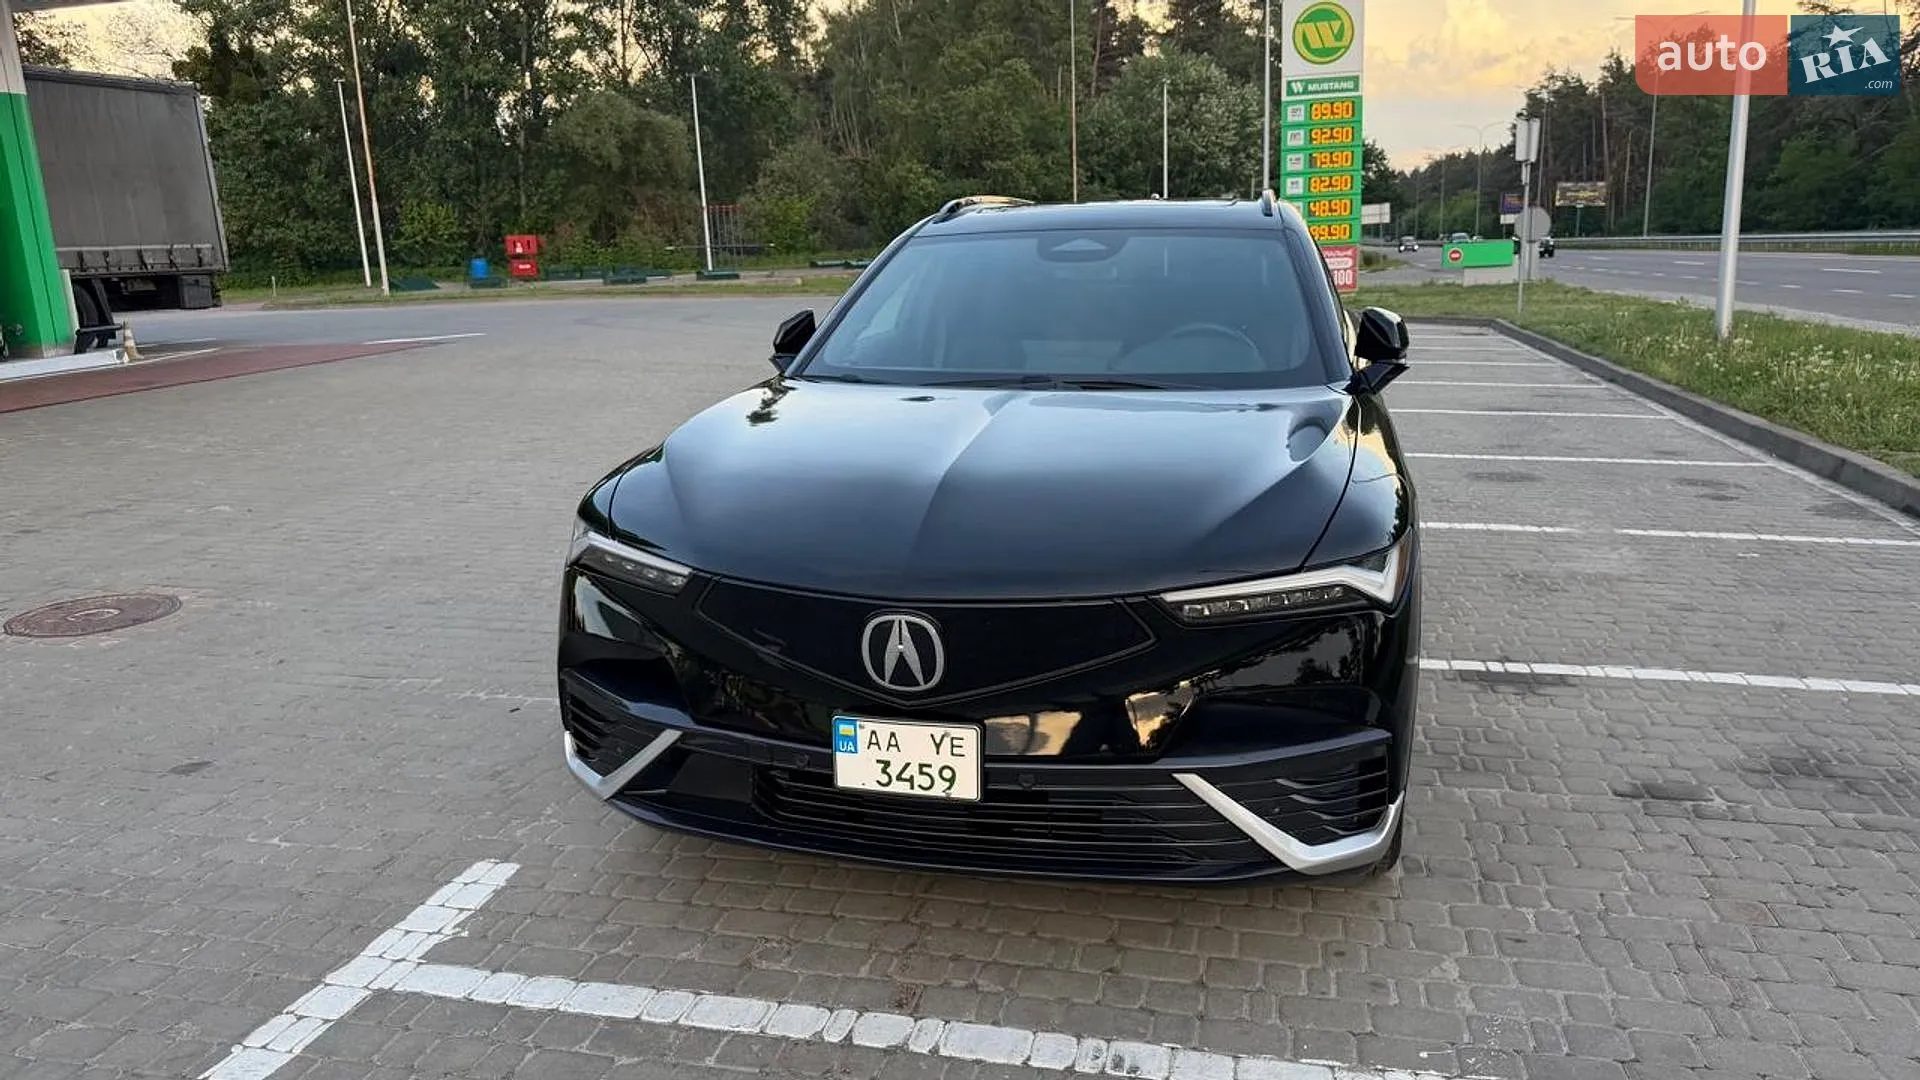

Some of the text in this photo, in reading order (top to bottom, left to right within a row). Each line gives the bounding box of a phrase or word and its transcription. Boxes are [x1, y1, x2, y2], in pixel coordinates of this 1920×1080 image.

[1308, 80, 1354, 91] MUSTANG
[1311, 101, 1353, 120] 89.90
[1311, 127, 1353, 145] 92.90
[1311, 151, 1353, 168] 79.90
[1310, 175, 1352, 193] 82.90
[1309, 199, 1351, 217] 48.90
[839, 741, 855, 752] UA
[867, 730, 965, 757] AA YE
[875, 759, 957, 793] 3459
